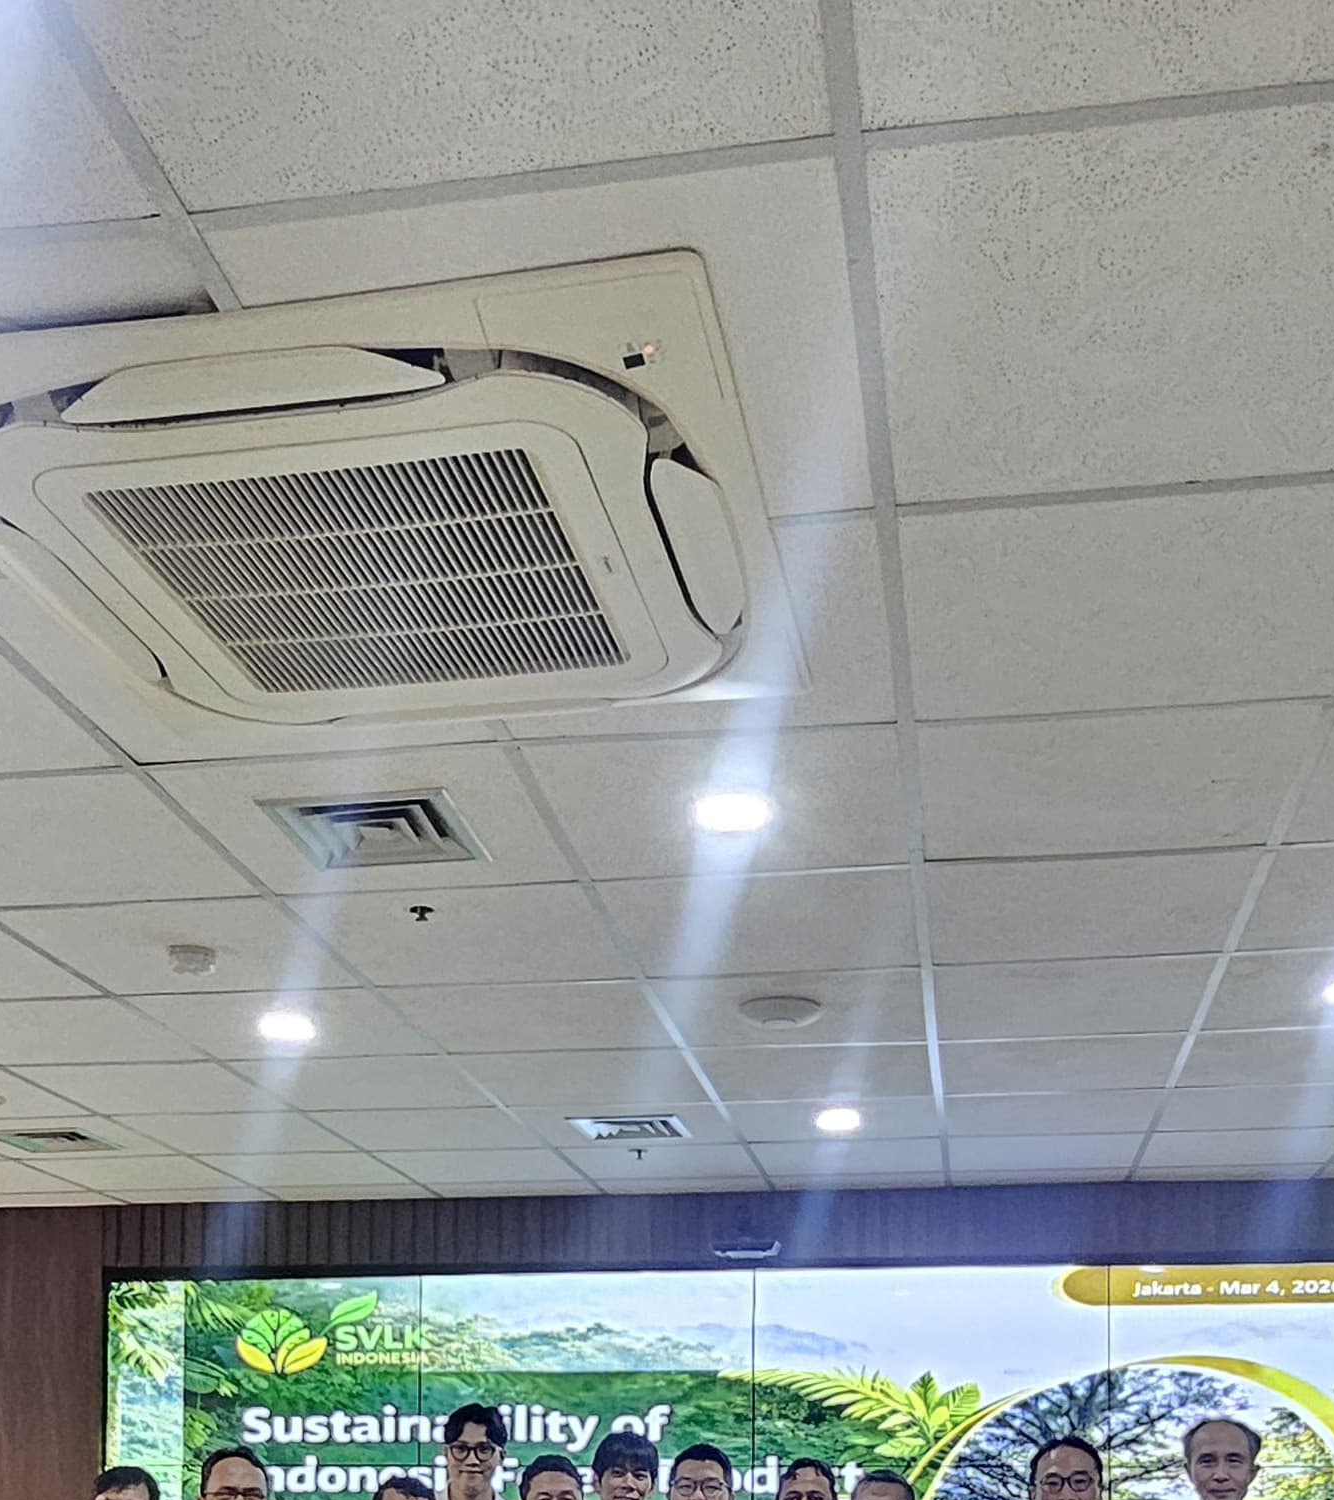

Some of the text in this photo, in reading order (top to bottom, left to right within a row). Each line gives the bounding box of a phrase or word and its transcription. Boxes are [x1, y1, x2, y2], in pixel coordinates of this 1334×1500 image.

[1132, 1281, 1202, 1298] Jakarta
[1219, 1280, 1262, 1296] Mar
[1265, 1280, 1286, 1297] 4,
[335, 1324, 433, 1351] SVLK
[335, 1351, 430, 1366] INDONESIA
[610, 1403, 672, 1443] of
